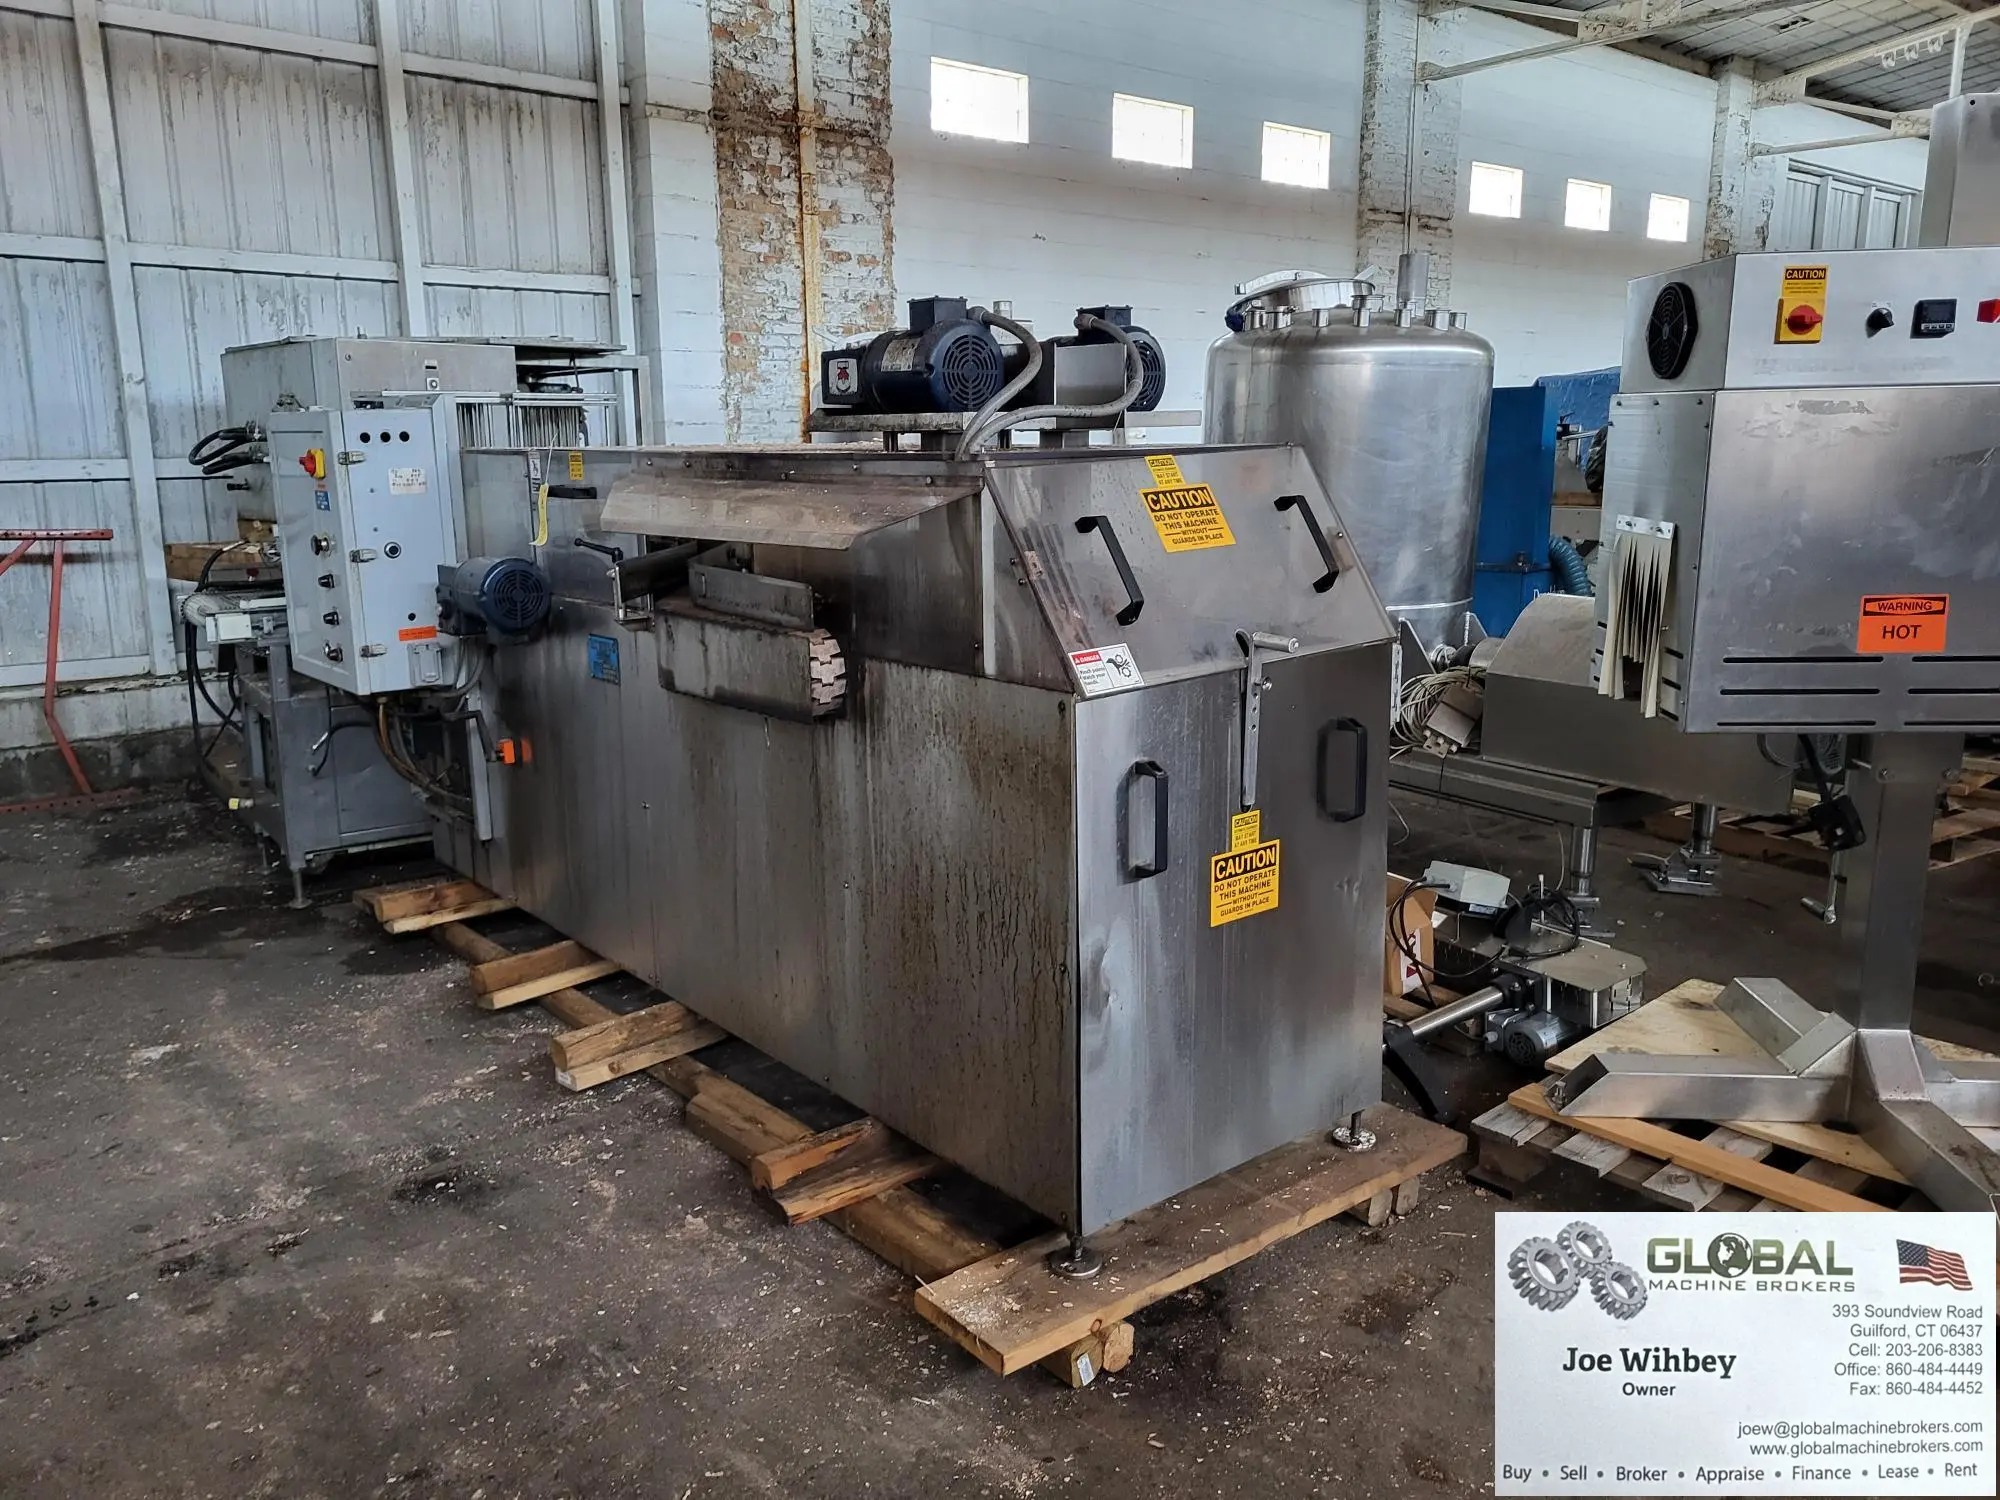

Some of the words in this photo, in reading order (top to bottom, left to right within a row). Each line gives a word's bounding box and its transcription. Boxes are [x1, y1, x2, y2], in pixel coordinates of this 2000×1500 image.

[1786, 269, 1825, 279] CAUTION
[1147, 488, 1213, 511] CAUTION
[1153, 512, 1166, 522] DO
[1167, 512, 1183, 520] NOT
[1184, 508, 1219, 519] OPERATE
[1163, 521, 1183, 530] THIS
[1184, 517, 1219, 528] MACHINE
[1180, 527, 1209, 535] WITHOUT
[1172, 535, 1197, 545] GUARDS
[1205, 532, 1224, 541] PLACE
[1877, 601, 1933, 611] WARNING
[1882, 624, 1922, 640] HOT
[1216, 846, 1275, 880] CAUTION
[1214, 883, 1225, 893] DO
[1227, 878, 1242, 889] NOT
[1244, 868, 1276, 884] OPERATE
[1220, 890, 1237, 901] THIS
[1238, 879, 1271, 895] MACHINE
[1232, 892, 1259, 905] WITHOUT
[1220, 905, 1244, 917] GUARDS
[1244, 902, 1251, 910] IN
[1251, 896, 1270, 907] PLACE
